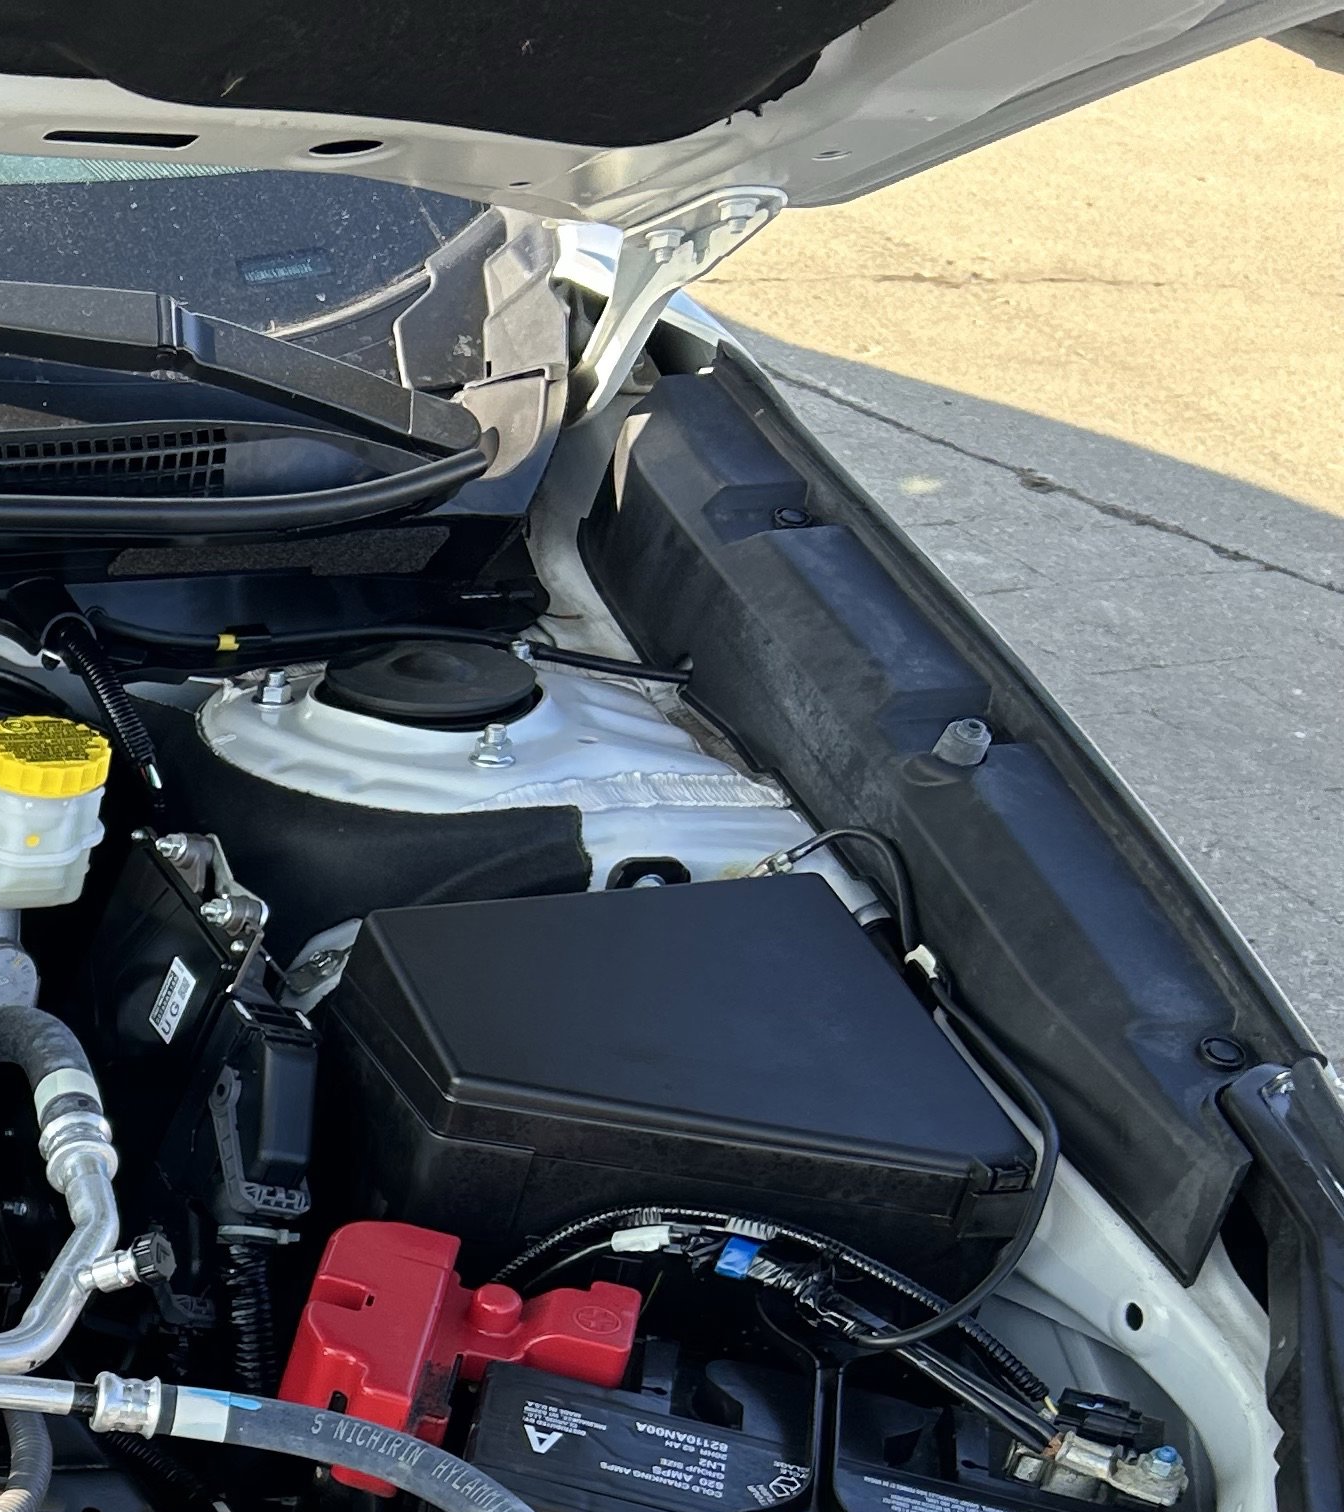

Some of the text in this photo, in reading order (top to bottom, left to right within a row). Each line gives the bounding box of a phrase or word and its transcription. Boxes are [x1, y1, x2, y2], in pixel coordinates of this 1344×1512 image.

[652, 1465, 694, 1483] AMPS
[659, 1457, 725, 1480] GROUP SIZE
[698, 1457, 726, 1472] LN2
[599, 1461, 723, 1499] COLD CRANKING AMPS
